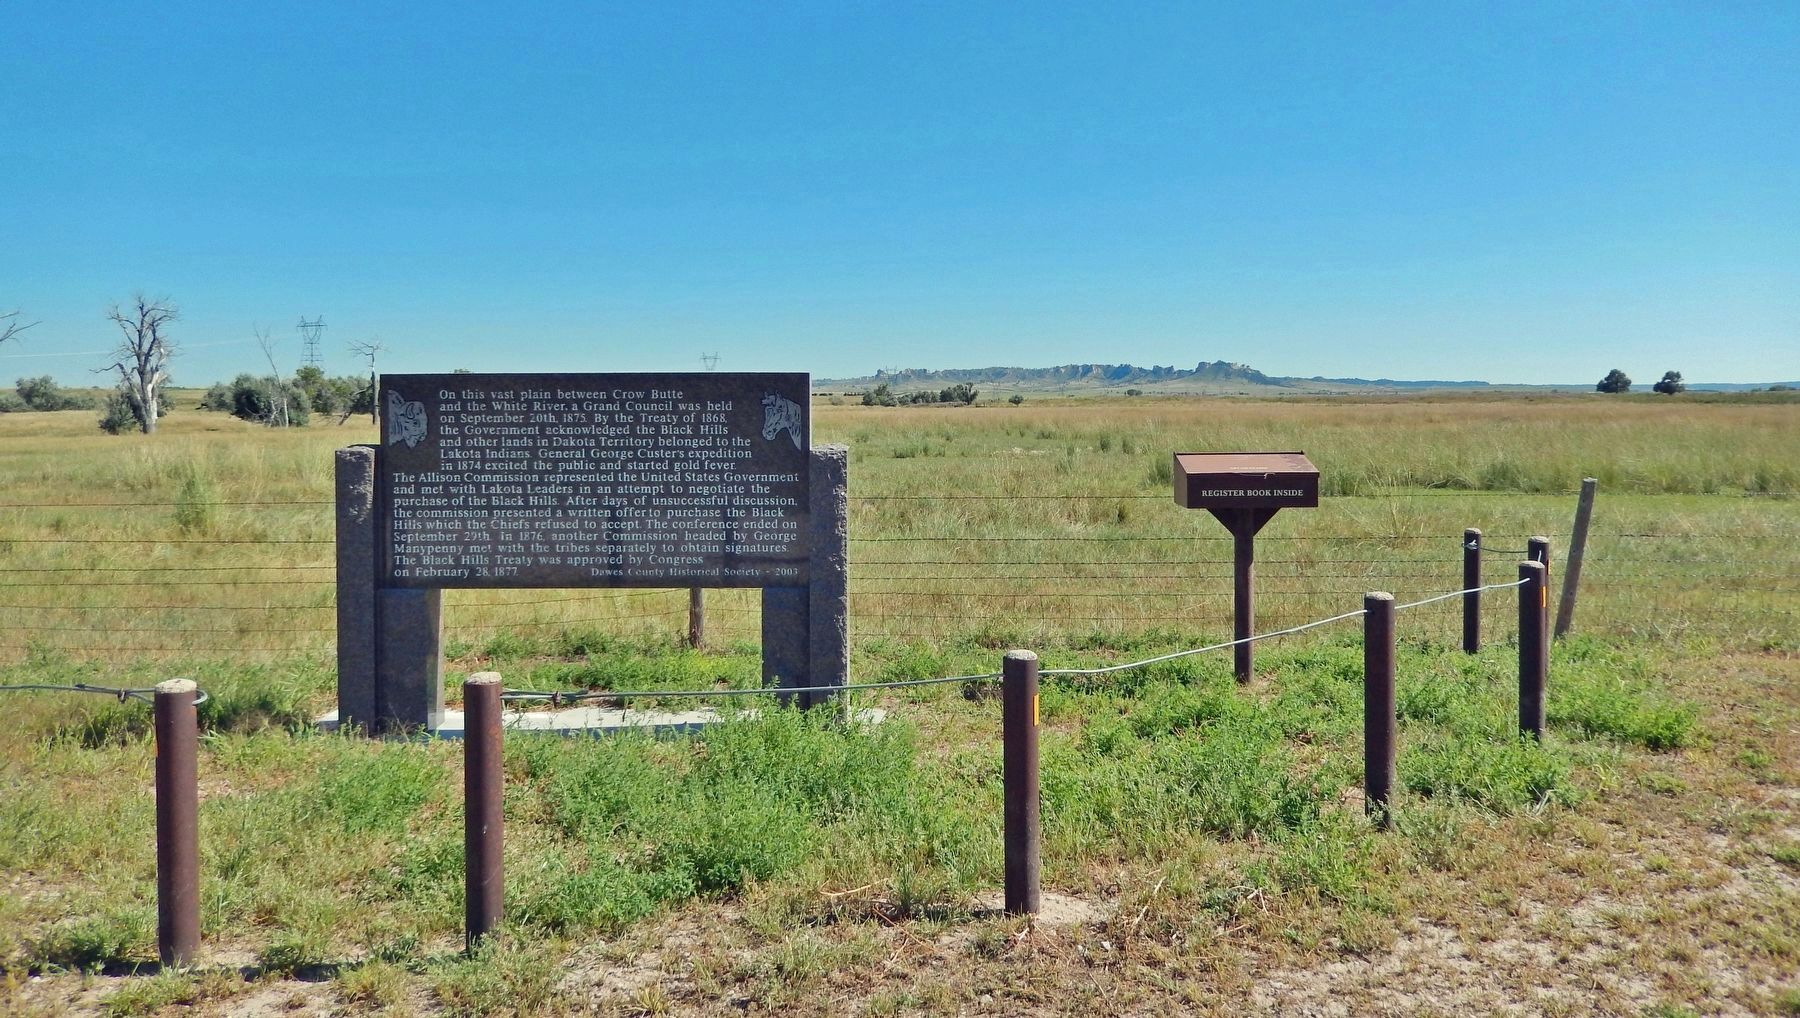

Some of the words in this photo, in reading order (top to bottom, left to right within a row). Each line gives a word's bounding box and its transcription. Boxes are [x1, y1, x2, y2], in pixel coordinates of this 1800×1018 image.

[439, 390, 456, 399] On
[462, 390, 485, 399] this
[490, 390, 514, 399] vast
[520, 390, 551, 401] plain
[557, 390, 607, 399] between
[612, 390, 645, 399] Crow
[651, 390, 683, 399] Butte
[439, 402, 462, 411] and
[467, 402, 487, 411] the
[491, 402, 527, 411] White
[583, 402, 620, 411] Grand
[625, 402, 673, 411] Council
[706, 402, 734, 411] held
[460, 413, 525, 425] September
[594, 413, 609, 425] By
[614, 413, 635, 423] the
[639, 413, 680, 425] Treaty
[682, 413, 697, 423] of
[439, 425, 459, 434] the
[464, 425, 540, 434] Government
[545, 425, 630, 437] acknowledged
[636, 425, 655, 434] the
[660, 425, 695, 434] Black
[699, 425, 728, 434] Hills
[439, 437, 461, 446] and
[465, 437, 498, 446] other
[501, 437, 533, 446] lands
[536, 437, 549, 446] in
[552, 437, 596, 446] Dakota
[599, 437, 655, 449] Territory
[658, 437, 712, 449] belonged
[716, 437, 729, 446] to
[732, 437, 751, 446] the
[439, 449, 481, 458] Lakota
[485, 449, 533, 458] Indians.
[537, 449, 586, 458] General
[590, 449, 634, 460] George
[637, 449, 685, 458] Custer's
[688, 449, 752, 460] expedition
[440, 461, 453, 470] in
[457, 461, 481, 470] 1874
[484, 461, 528, 470] excited
[533, 461, 553, 470] the
[558, 461, 596, 472] public
[599, 461, 621, 470] and
[627, 461, 669, 470] started
[674, 461, 700, 472] gold
[704, 461, 737, 470] fever.
[392, 473, 415, 482] The
[418, 473, 461, 482] Allison
[463, 473, 539, 482] Commission
[544, 473, 614, 484] represented
[618, 473, 637, 482] the
[641, 473, 681, 482] United
[685, 473, 720, 482] States
[723, 473, 799, 482] Government
[392, 484, 415, 494] and
[421, 484, 444, 494] met
[449, 484, 476, 494] with
[481, 484, 523, 494] Lakota
[526, 484, 573, 494] Leaders
[579, 484, 591, 494] in
[617, 484, 665, 496] attempt
[670, 484, 683, 494] to
[688, 484, 745, 496] negotiate
[751, 484, 770, 494] the
[394, 496, 448, 508] purchase
[451, 496, 466, 505] of
[468, 496, 487, 505] the
[491, 496, 525, 505] Black
[564, 496, 598, 505] After
[601, 496, 628, 508] days
[633, 496, 647, 505] of
[652, 496, 728, 505] unsuccessful
[393, 508, 413, 517] the
[416, 508, 488, 517] commission
[493, 508, 551, 520] presented
[567, 508, 611, 517] written
[615, 508, 647, 517] offer
[648, 508, 661, 517] to
[666, 508, 721, 520] purchase
[726, 508, 746, 517] the
[752, 508, 785, 517] Black
[394, 520, 422, 529] Hills
[425, 520, 462, 529] which
[467, 520, 486, 529] the
[490, 520, 530, 529] Chiefs
[535, 520, 579, 529] refused
[584, 520, 596, 529] to
[645, 520, 668, 529] The
[672, 520, 739, 529] conference
[743, 520, 778, 529] ended
[393, 532, 458, 543] September
[500, 532, 513, 541] In
[551, 532, 599, 541] another
[602, 532, 677, 541] Commission
[684, 532, 726, 541] headed
[733, 532, 748, 543] by
[753, 532, 797, 543] George
[394, 543, 464, 555] Manypenny
[469, 543, 492, 553] met
[498, 543, 524, 553] with
[531, 543, 549, 553] the
[556, 543, 590, 553] tribes
[595, 543, 656, 555] separately
[662, 543, 674, 553] to
[680, 543, 719, 553] obtain
[394, 555, 417, 565] The
[422, 555, 455, 565] Black
[460, 555, 489, 565] Hills
[494, 555, 534, 567] Treaty
[565, 555, 623, 567] approved
[628, 555, 643, 567] by
[648, 555, 704, 567] Congress
[415, 567, 470, 579] February
[591, 568, 623, 576] Dawes
[627, 568, 664, 578] County
[669, 568, 719, 576] Historical
[724, 568, 761, 578] Society
